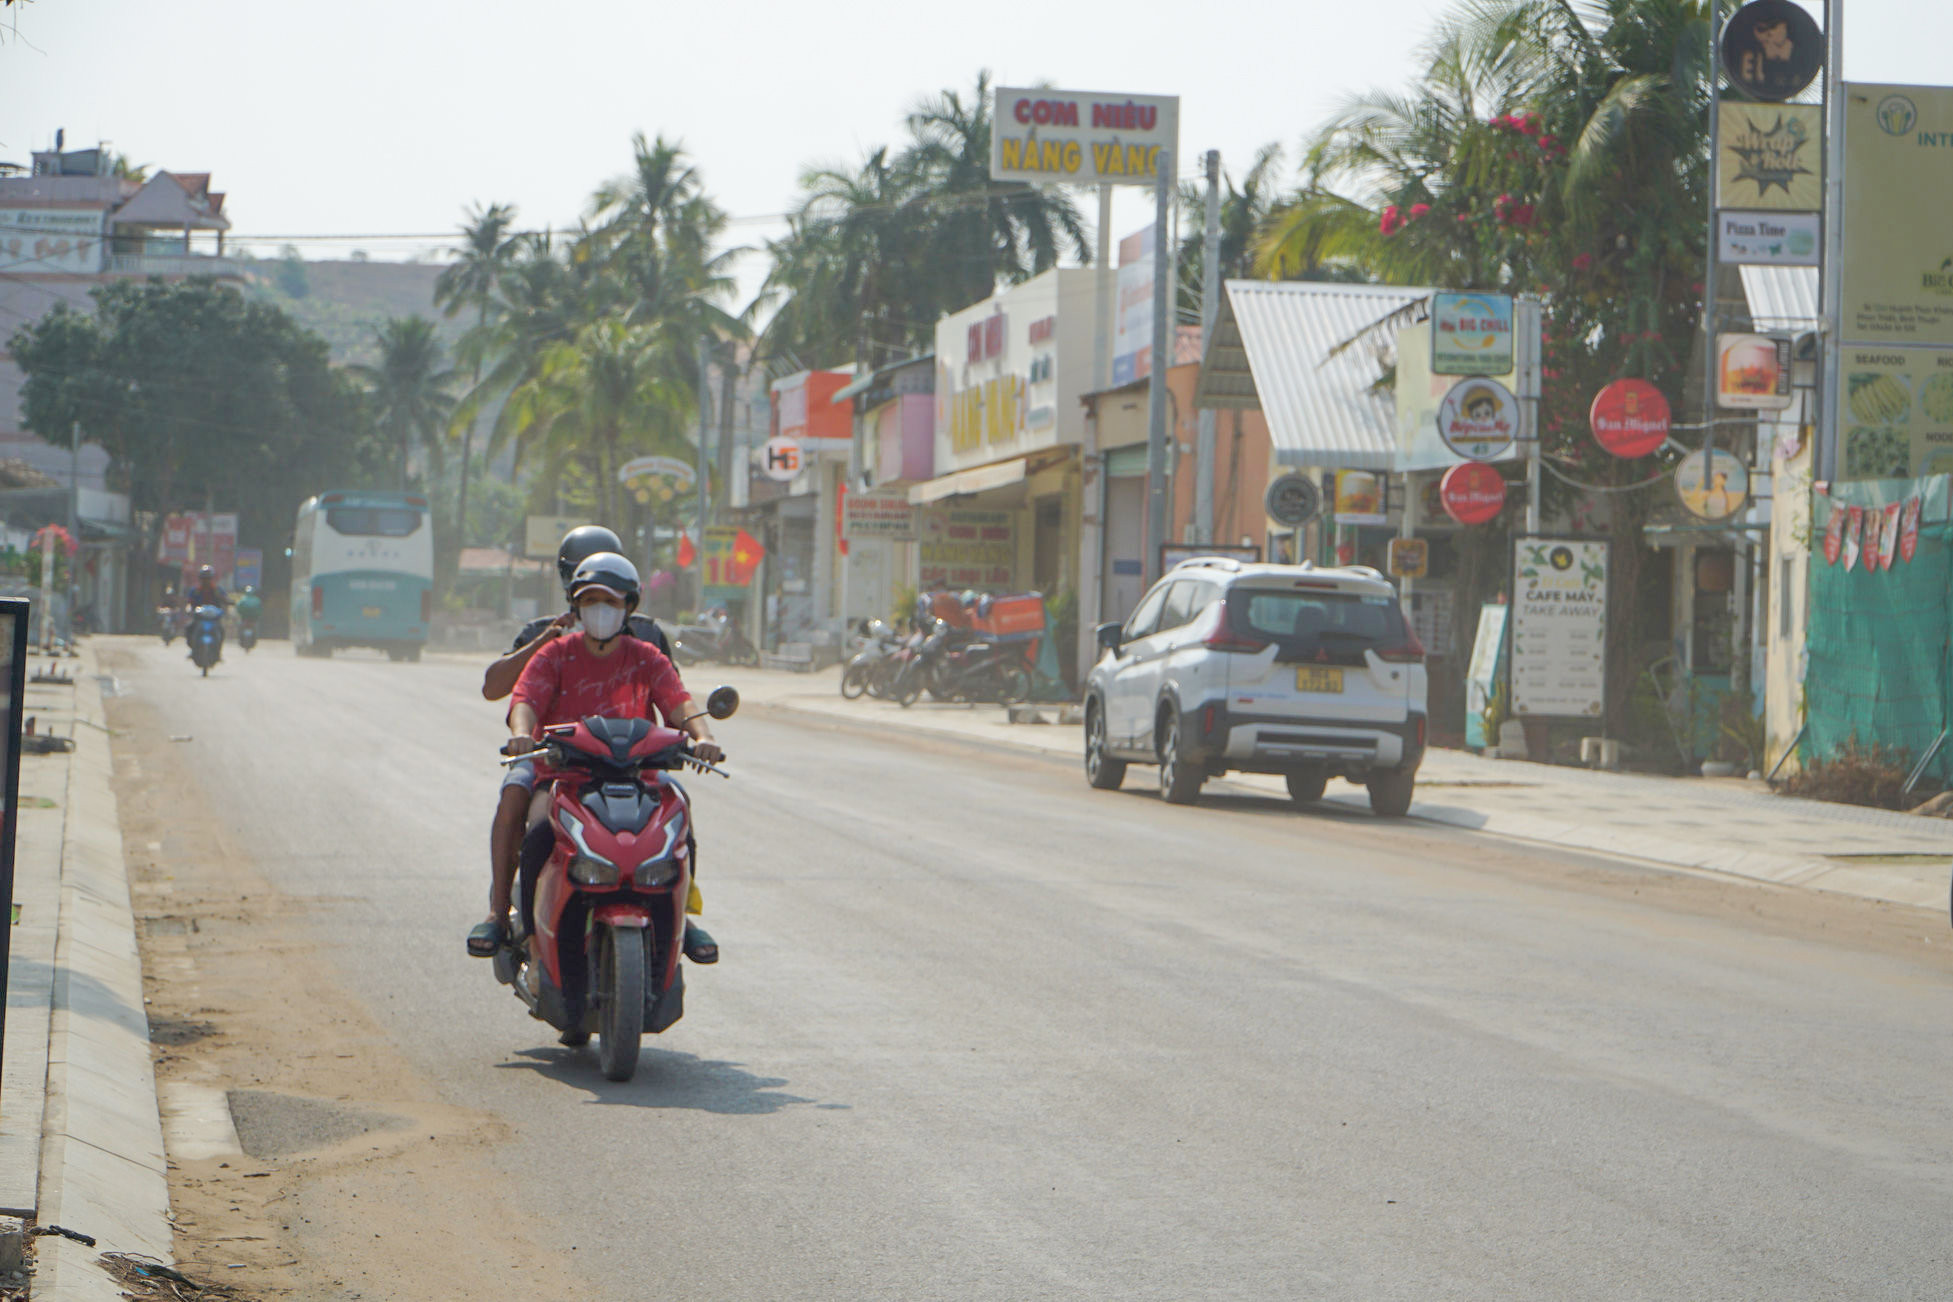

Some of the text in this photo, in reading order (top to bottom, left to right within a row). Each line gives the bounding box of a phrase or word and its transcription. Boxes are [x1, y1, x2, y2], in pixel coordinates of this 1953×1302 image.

[1759, 222, 1786, 237] Time
[1855, 355, 1906, 366] SEAFOOD
[1523, 604, 1599, 617] TAKE AWAY
